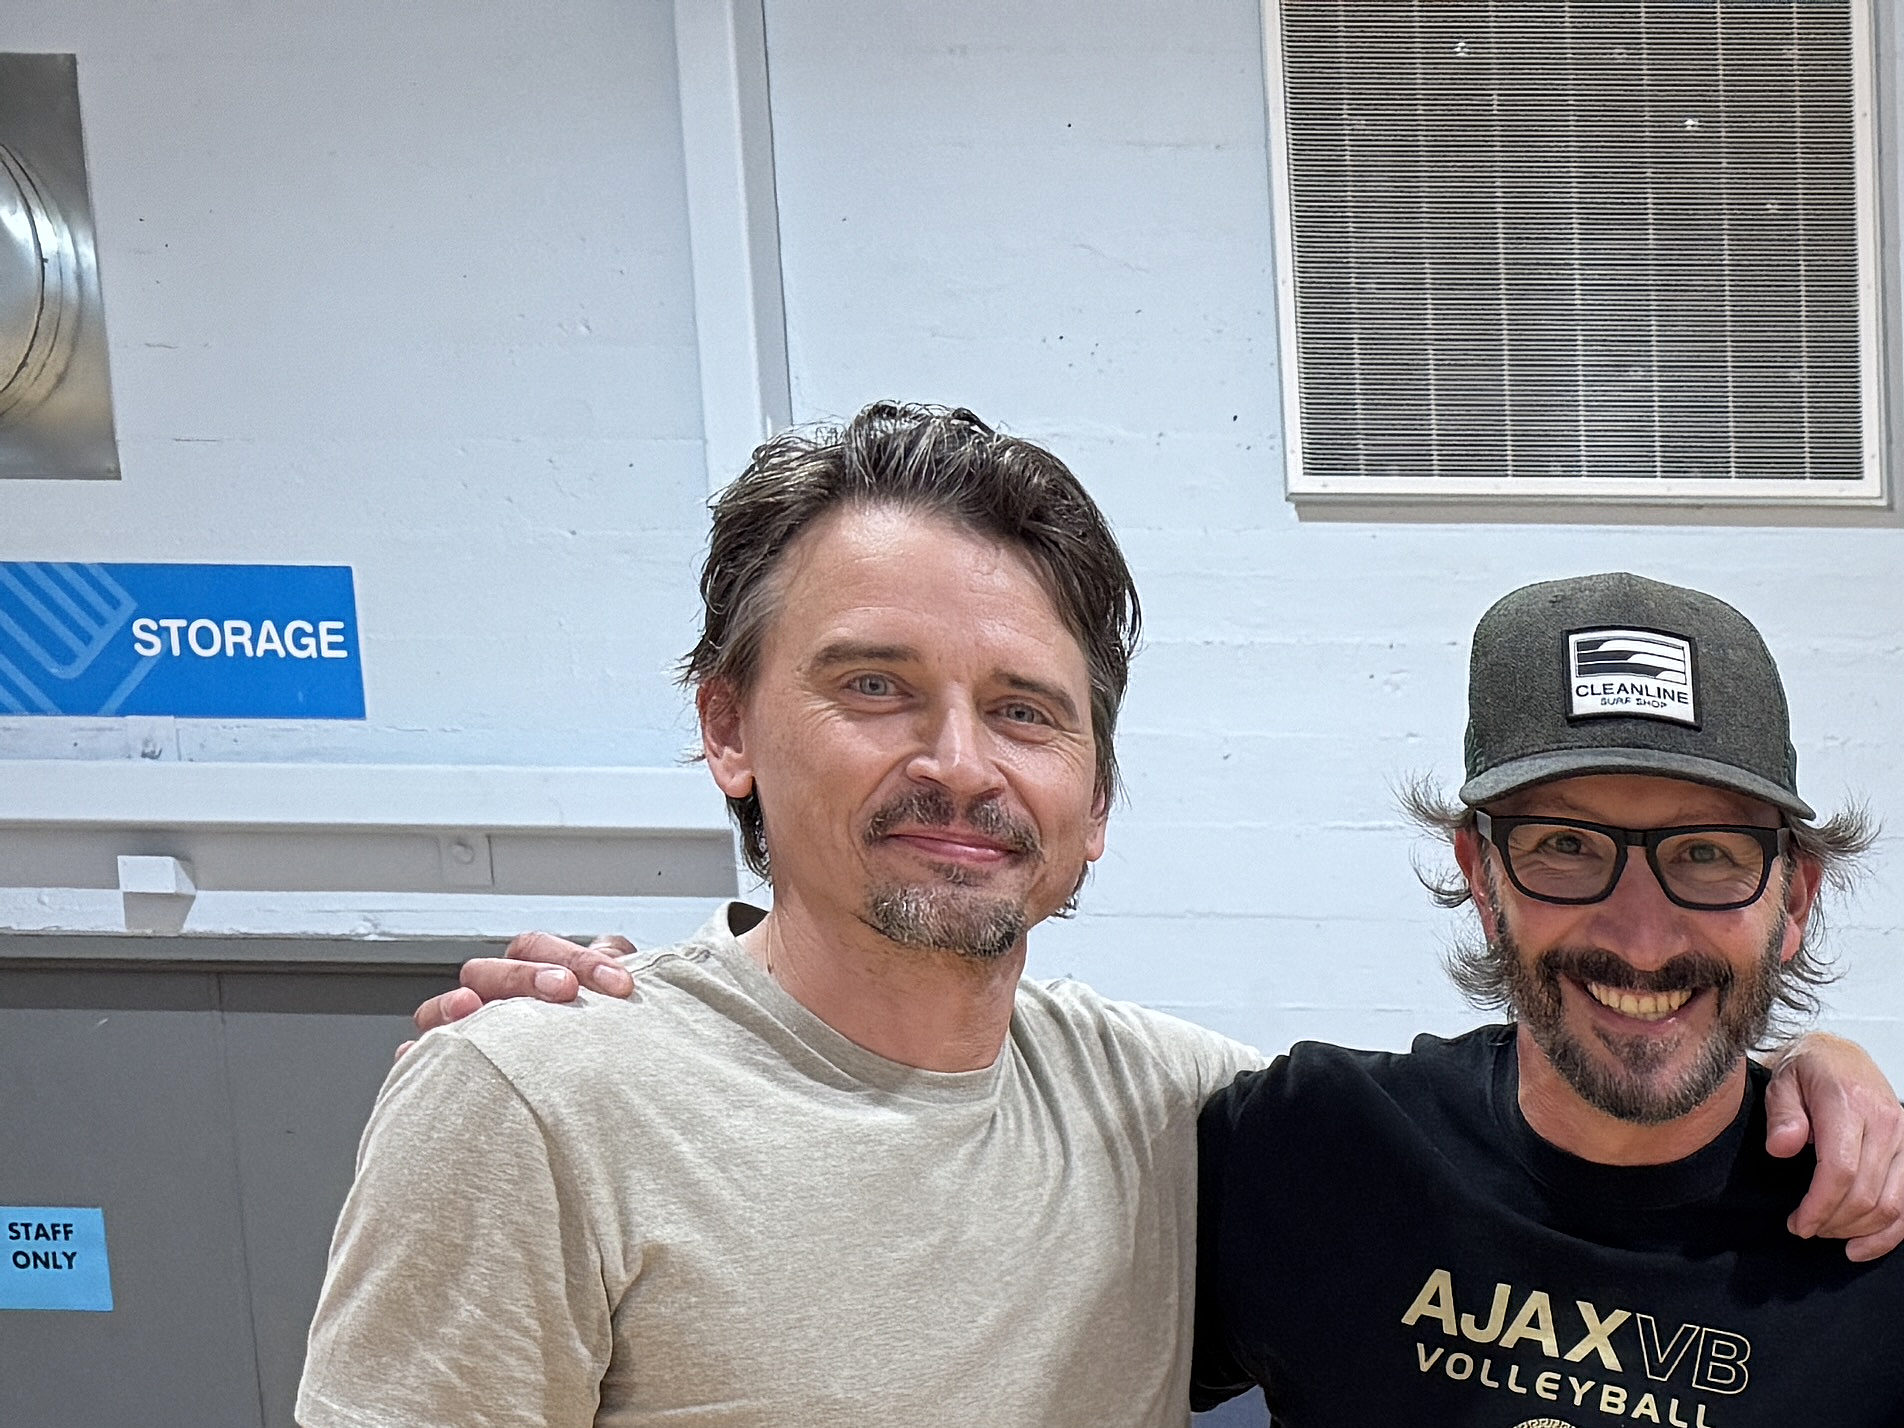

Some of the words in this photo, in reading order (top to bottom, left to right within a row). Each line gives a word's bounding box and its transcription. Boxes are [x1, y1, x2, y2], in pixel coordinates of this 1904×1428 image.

[132, 618, 348, 659] STORAGE
[1576, 683, 1689, 704] CLEANLINE
[8, 1222, 74, 1241] STAFF
[12, 1251, 77, 1270] ONLY
